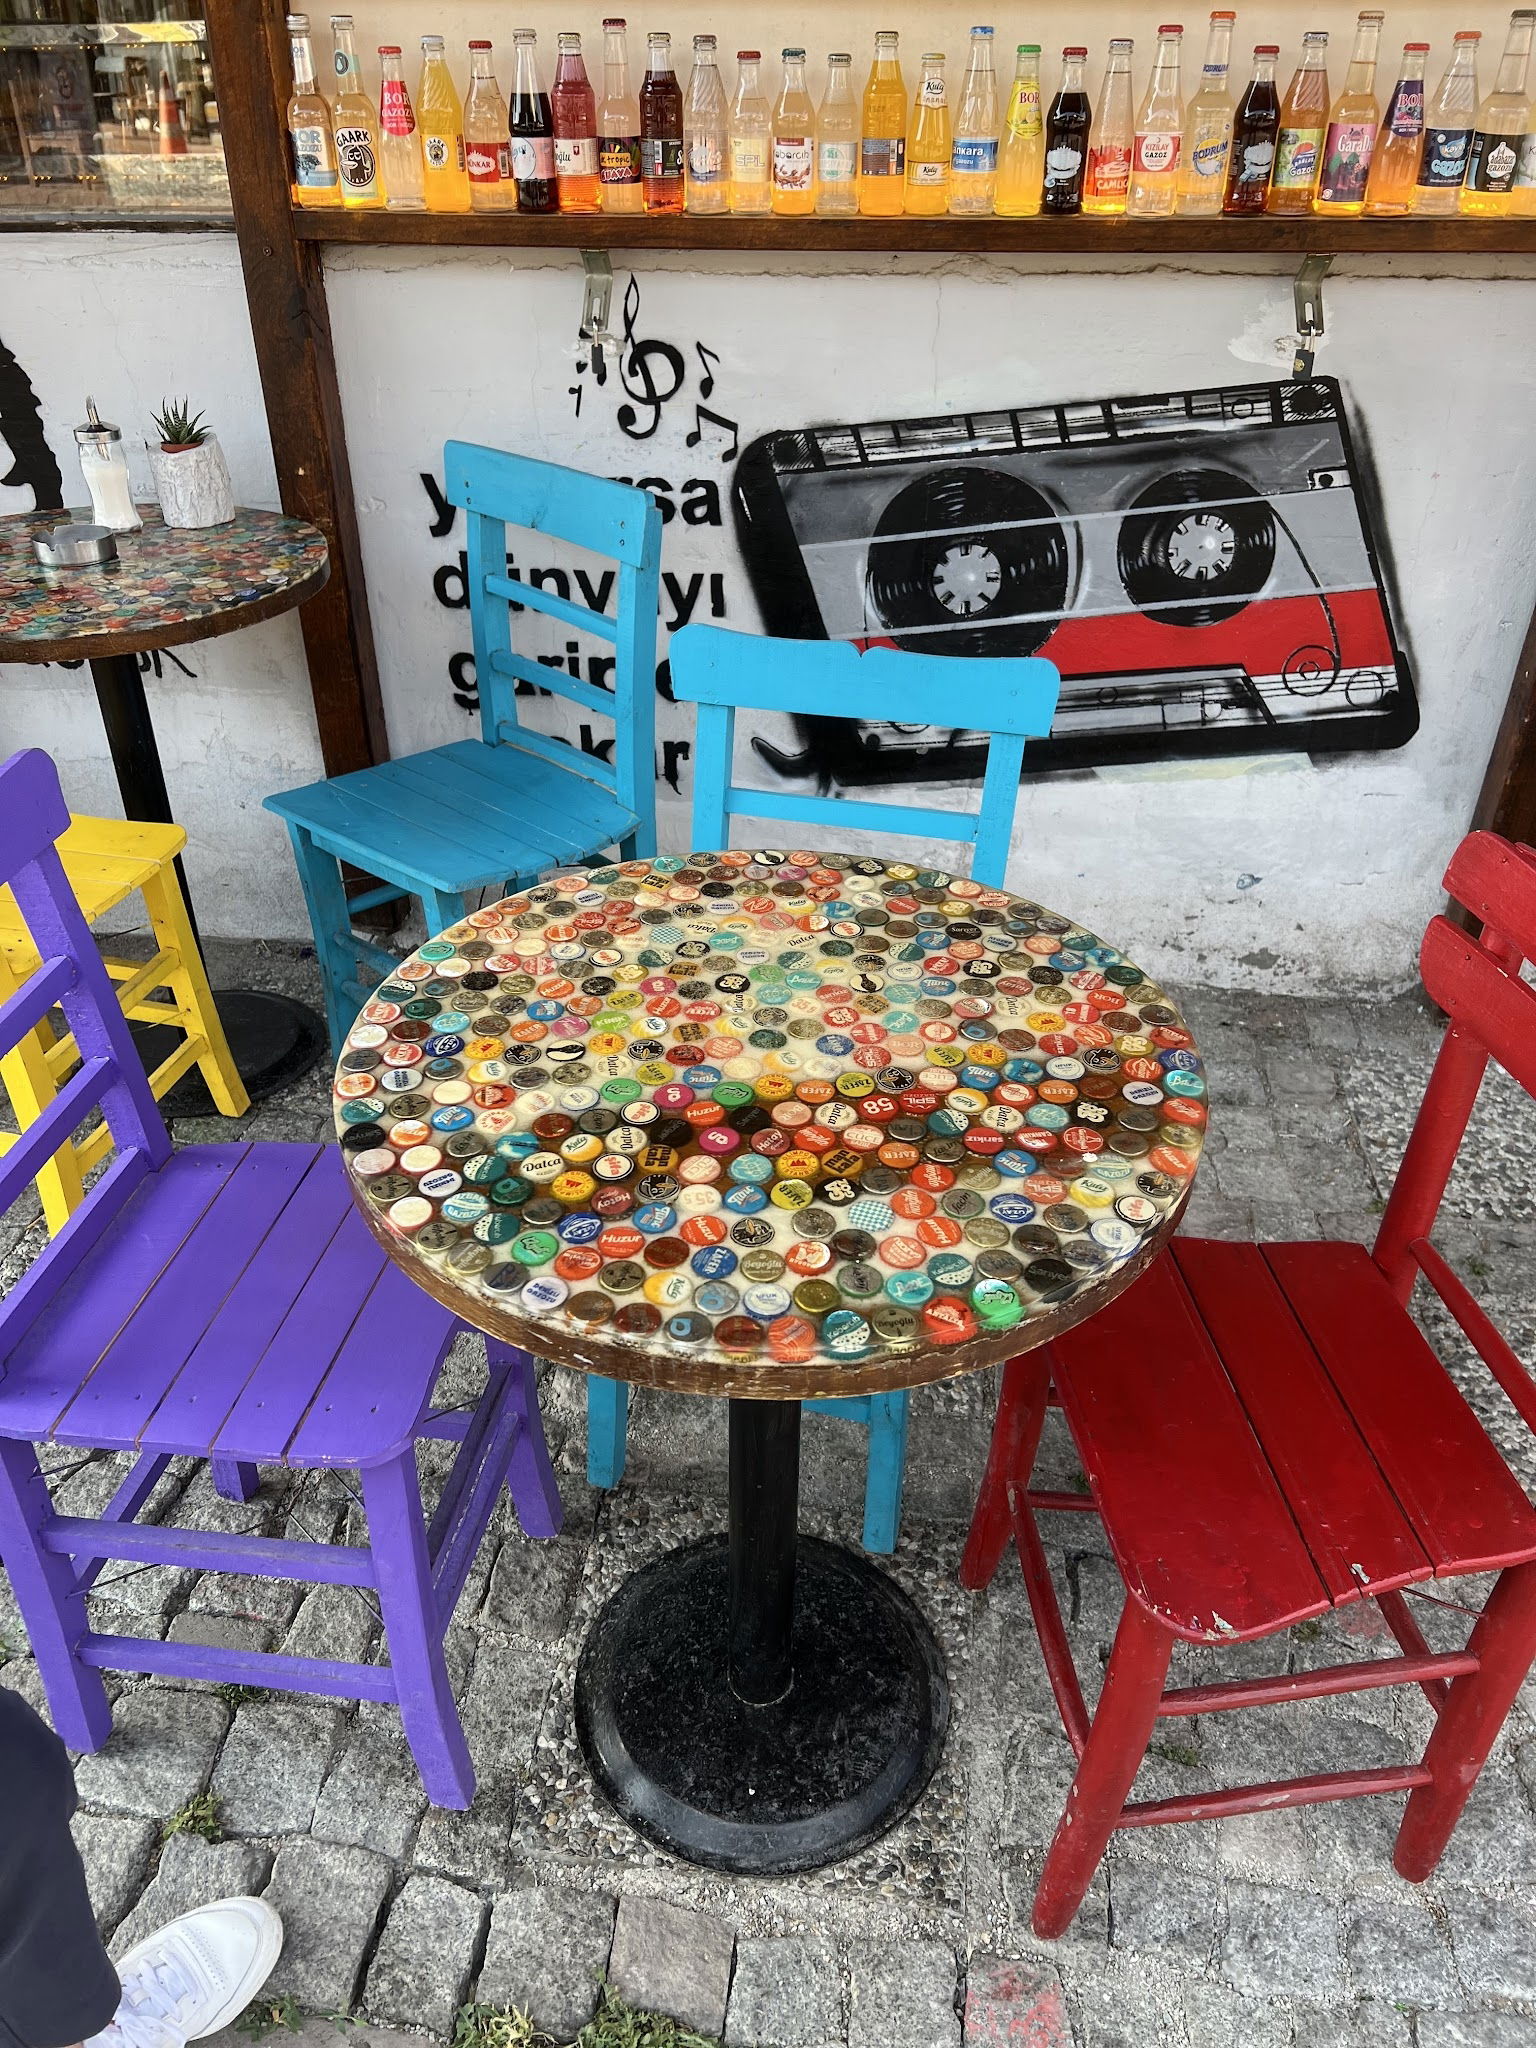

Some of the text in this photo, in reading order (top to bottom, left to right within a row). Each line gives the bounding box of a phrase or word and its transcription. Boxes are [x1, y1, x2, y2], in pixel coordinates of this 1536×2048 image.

[337, 130, 370, 147] GAARK
[1193, 142, 1229, 160] BODRUM
[1094, 994, 1120, 1005] BOR
[837, 1080, 872, 1091] ZAFER
[1042, 1087, 1075, 1095] ZAFER
[687, 1104, 722, 1118] Huzur
[863, 1098, 894, 1115] 58
[758, 1130, 783, 1151] Hatay
[598, 1193, 631, 1209] Hatay
[780, 1184, 803, 1206] ZAFER
[693, 1217, 717, 1241] Huzur
[927, 1220, 951, 1244] Huzur
[601, 1234, 642, 1244] Huzur
[705, 1248, 727, 1274] ZAFER
[744, 1259, 784, 1269] Beyoğlu
